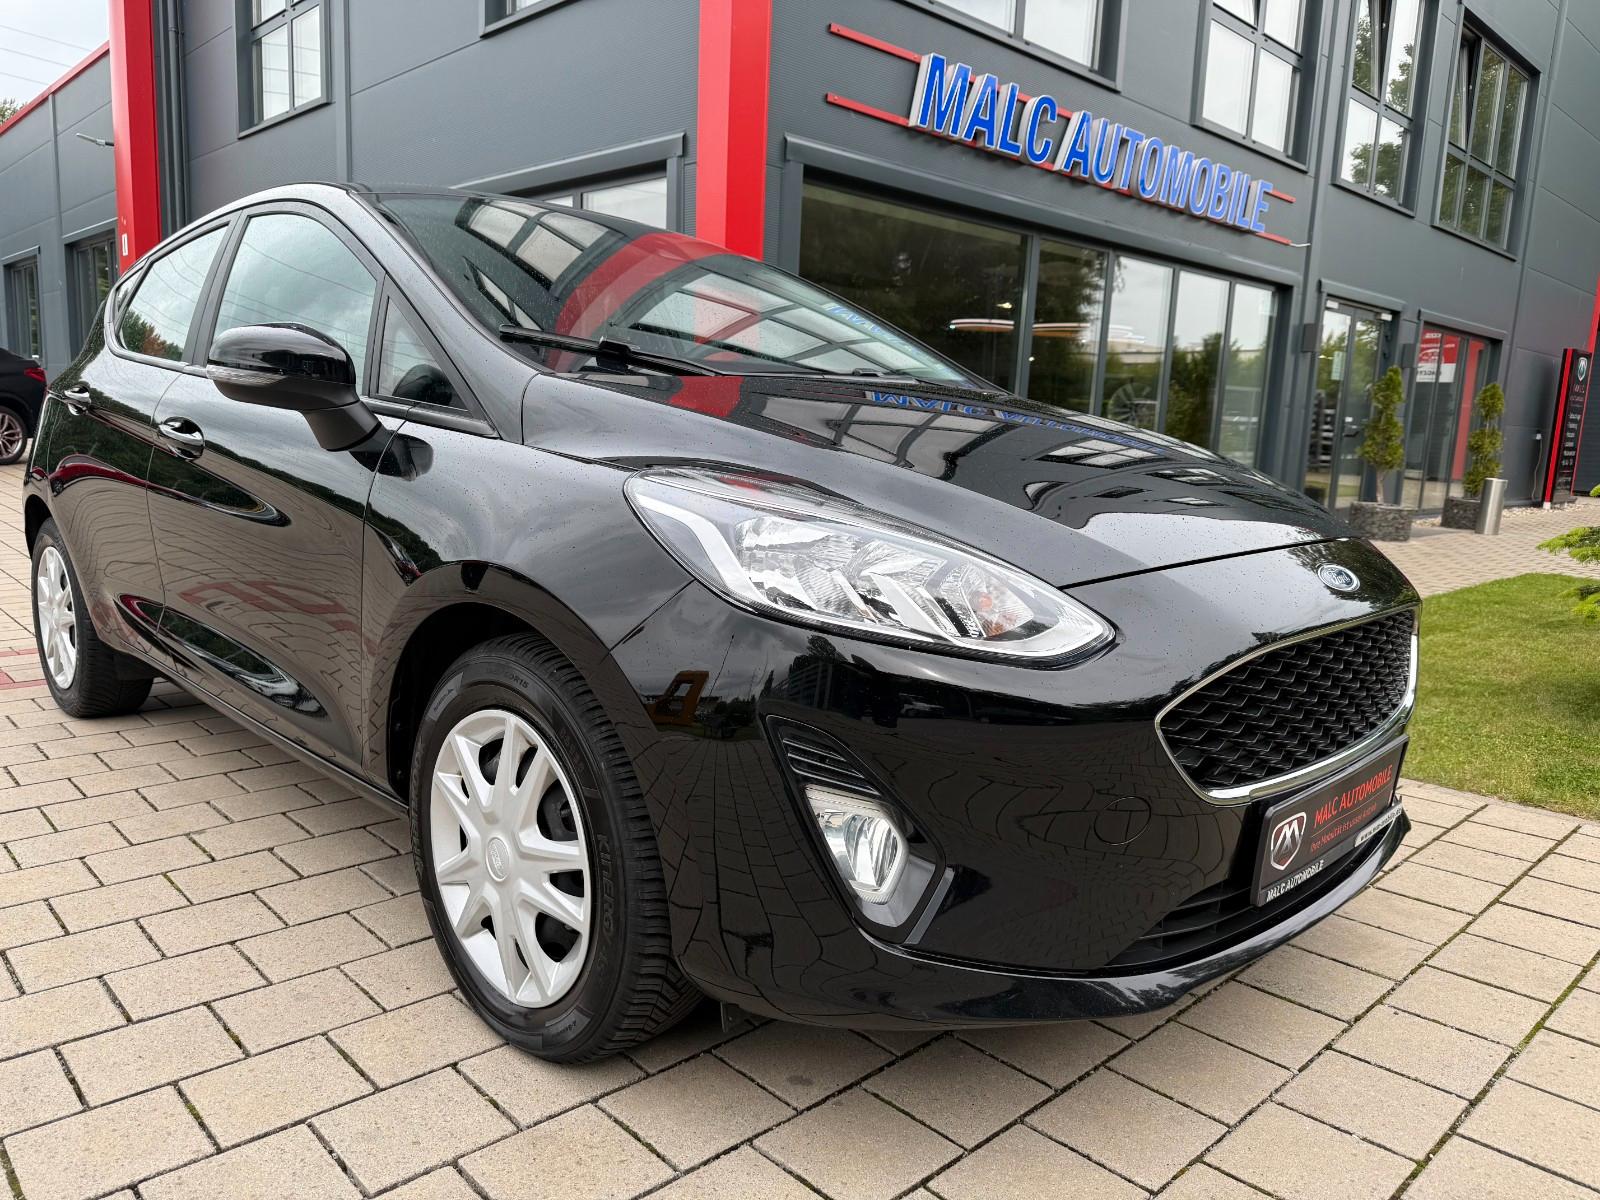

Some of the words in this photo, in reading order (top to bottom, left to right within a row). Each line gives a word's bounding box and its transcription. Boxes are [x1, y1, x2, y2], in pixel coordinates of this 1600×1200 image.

[909, 52, 1059, 164] MALC
[1054, 110, 1274, 233] AUTOMOBILE
[1313, 796, 1339, 829] MALC
[1339, 764, 1394, 810] AUTOMOBILE
[1266, 882, 1286, 902] MALC
[1285, 859, 1325, 892] AUTOMOBILE
